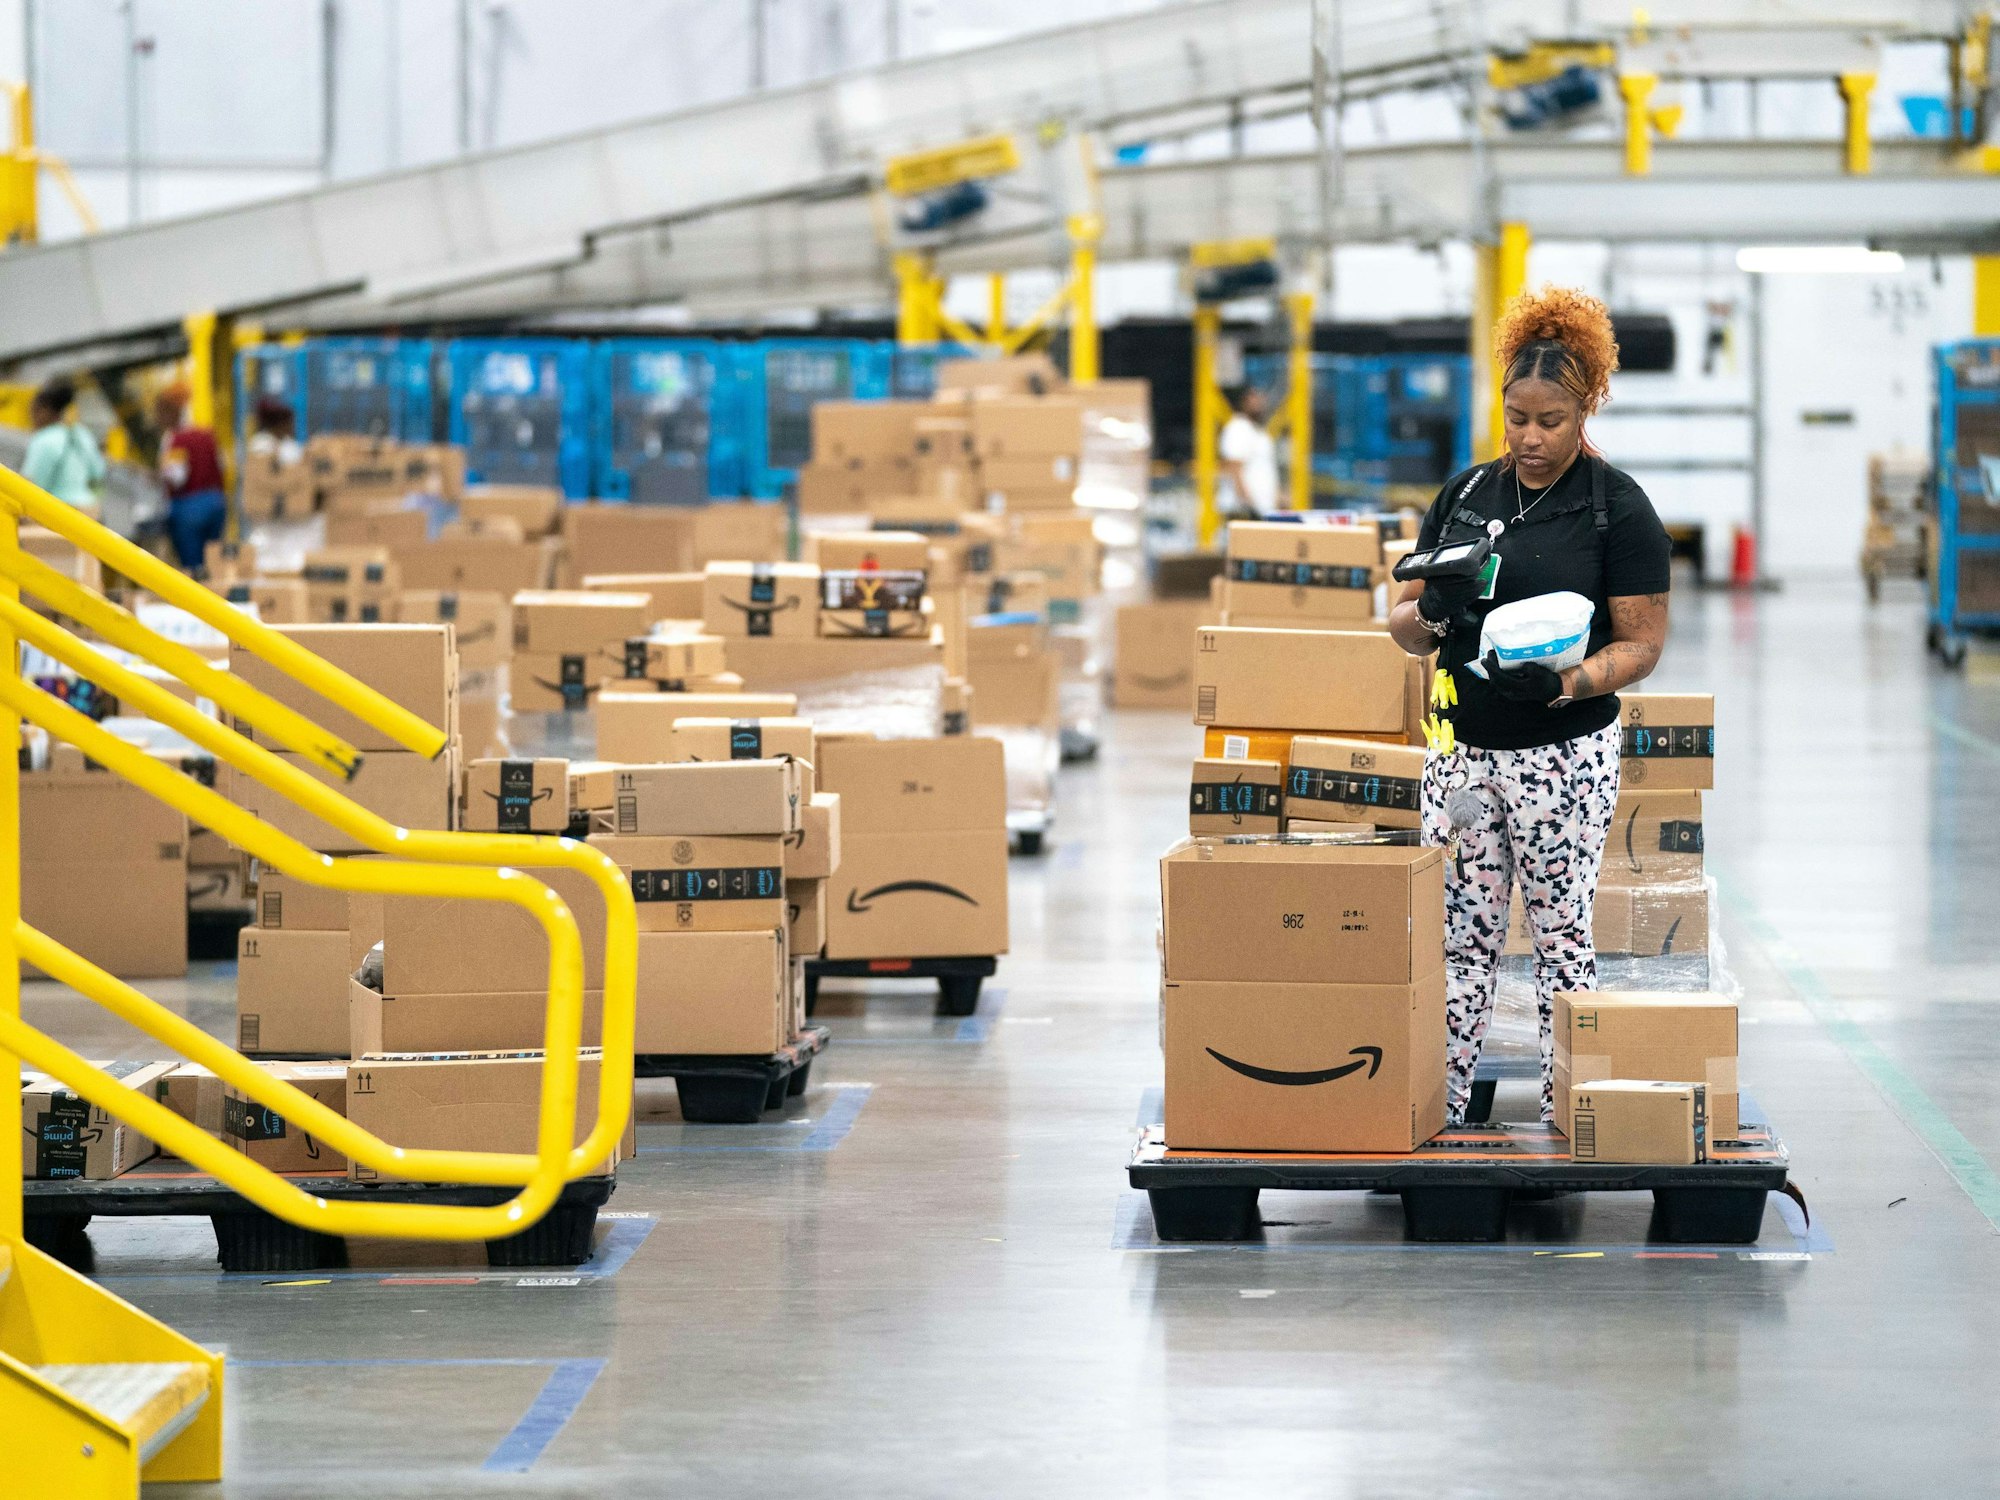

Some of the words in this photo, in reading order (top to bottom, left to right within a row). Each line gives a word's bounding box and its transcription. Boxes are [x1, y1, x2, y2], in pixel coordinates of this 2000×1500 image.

[733, 740, 758, 749] prime
[1636, 729, 1645, 754] prime
[1300, 769, 1309, 796] prime
[1370, 777, 1380, 803] prime
[505, 796, 530, 806] prime
[1219, 786, 1228, 811] prime
[1243, 786, 1253, 811] prime
[686, 871, 696, 897] prime
[758, 869, 767, 896] prime
[1282, 913, 1304, 929] 296
[44, 1132, 74, 1142] prime
[50, 1165, 80, 1177] prime
